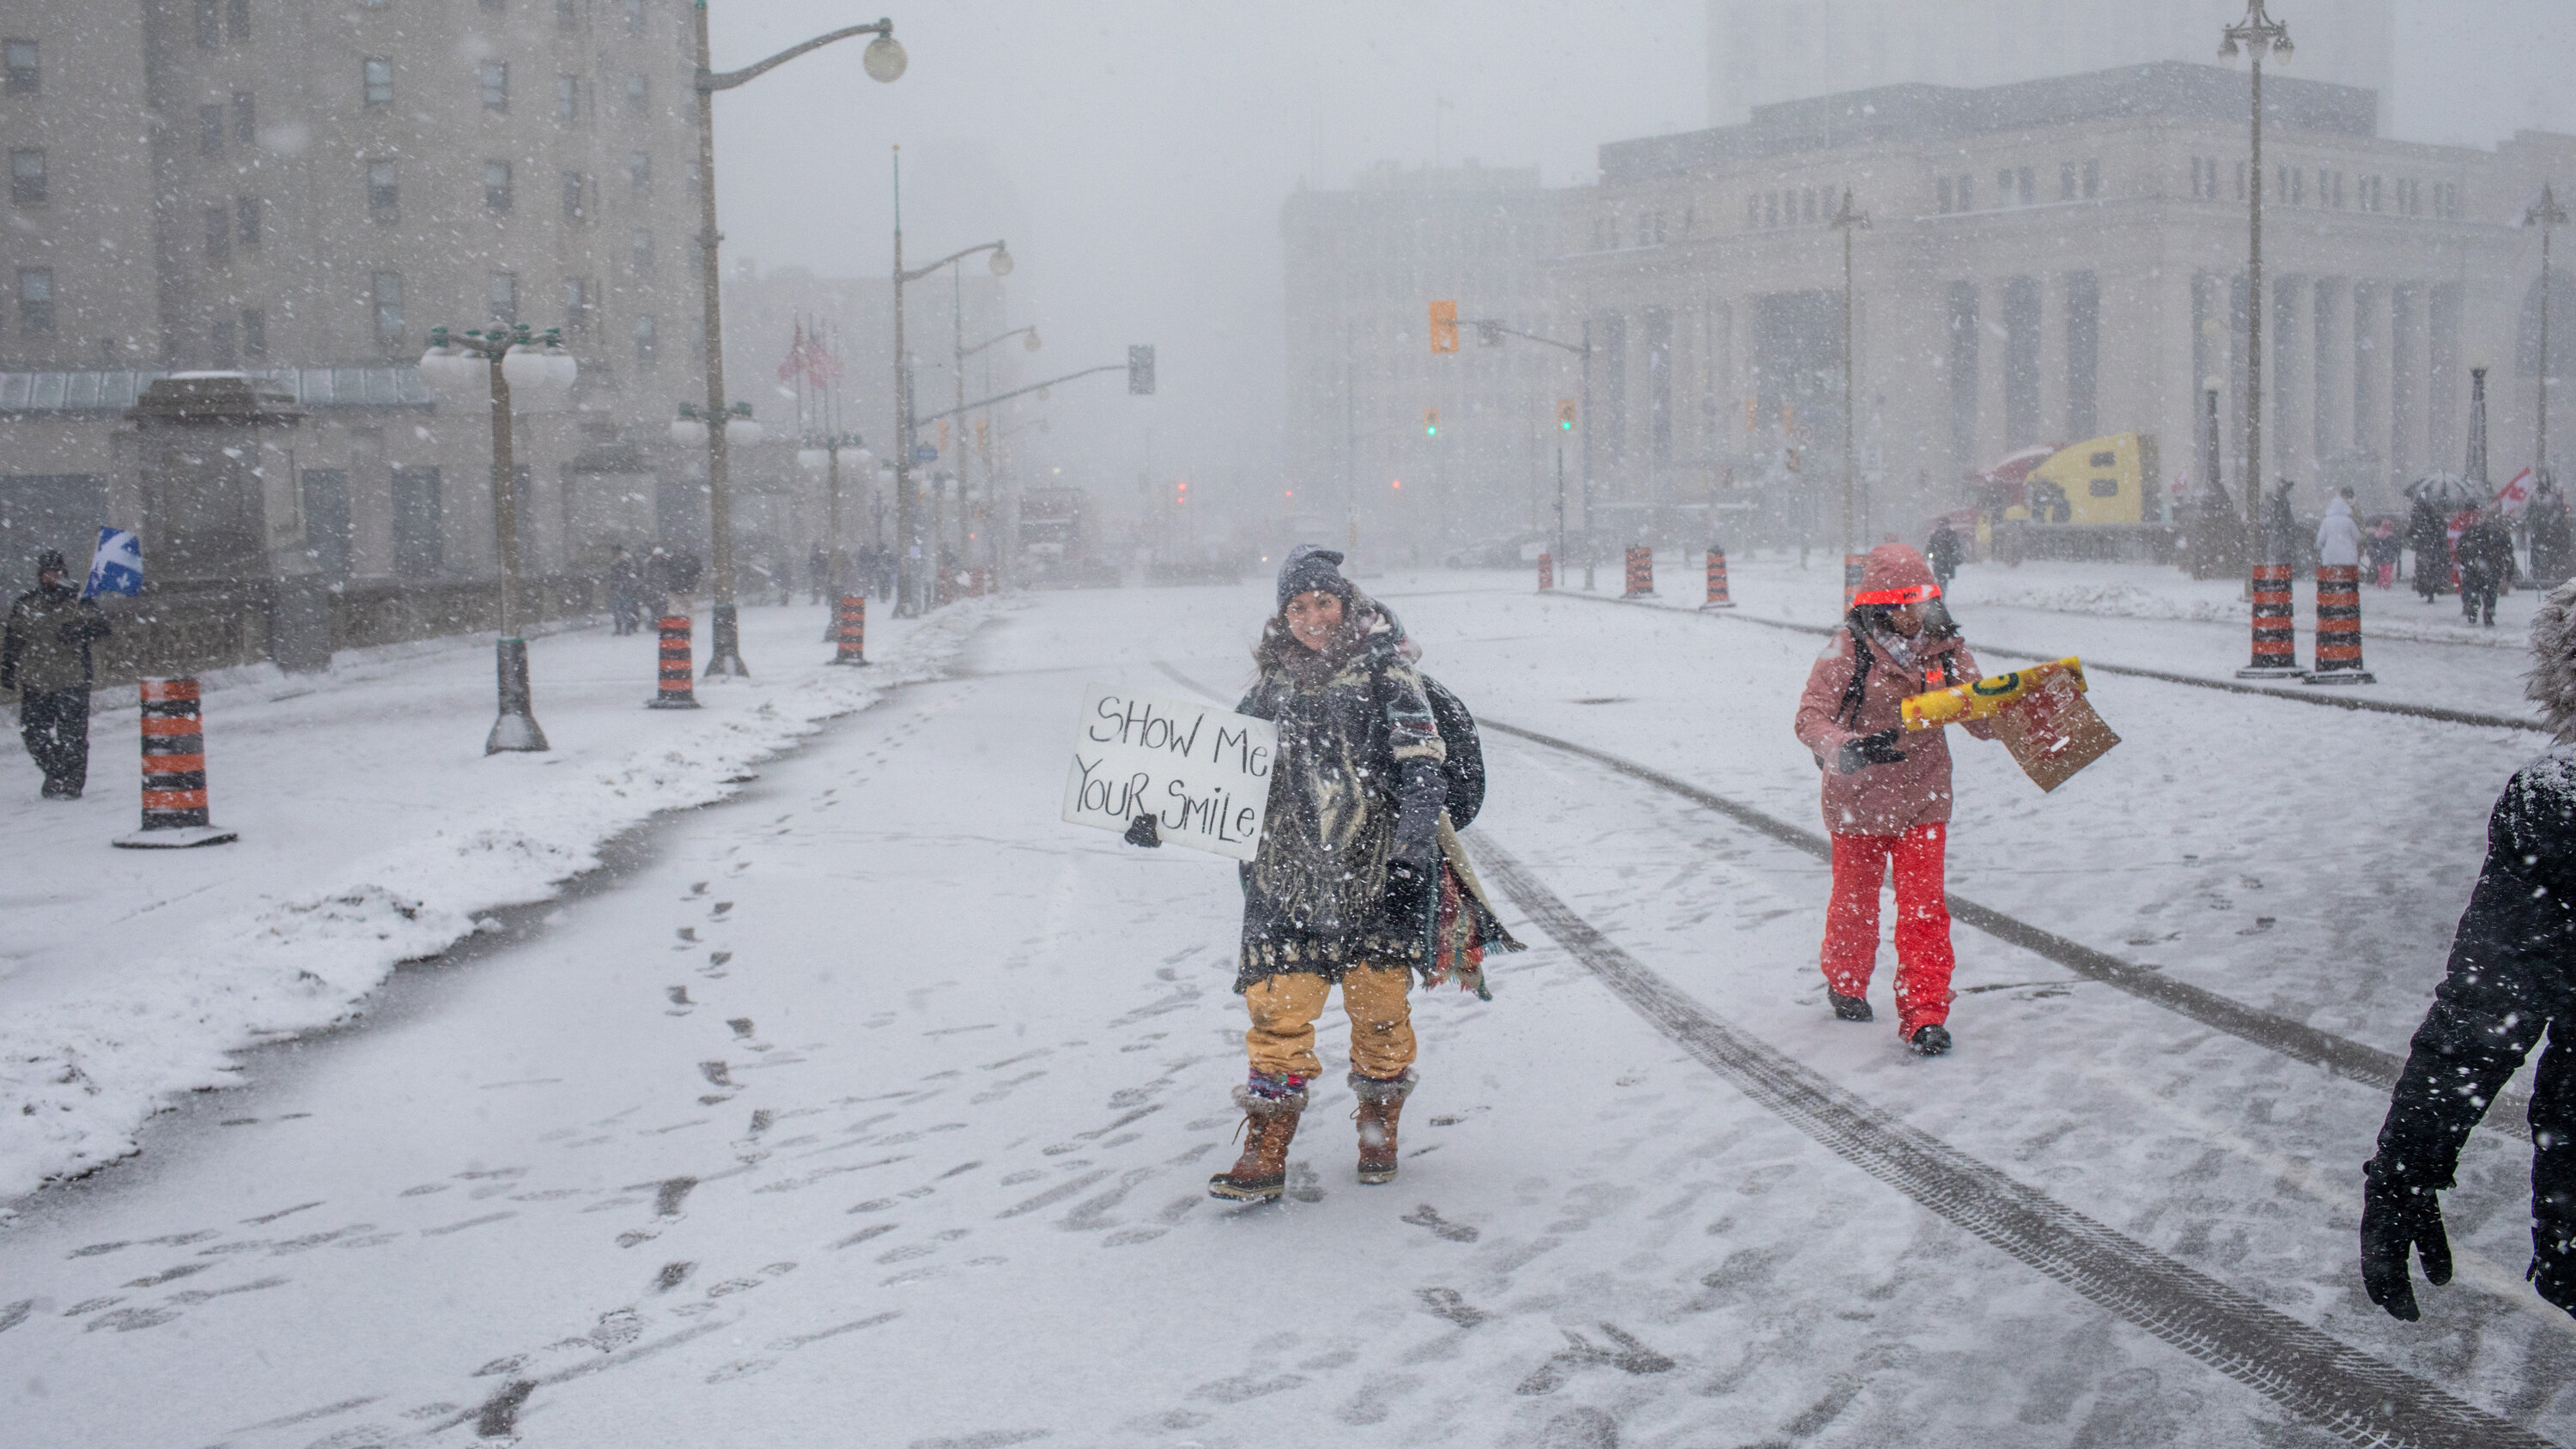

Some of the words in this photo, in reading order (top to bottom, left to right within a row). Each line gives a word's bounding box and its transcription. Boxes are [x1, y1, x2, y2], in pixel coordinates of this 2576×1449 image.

[1089, 696, 1205, 758] SHOW
[1213, 726, 1268, 777] Me
[1075, 754, 1150, 822] YOUR
